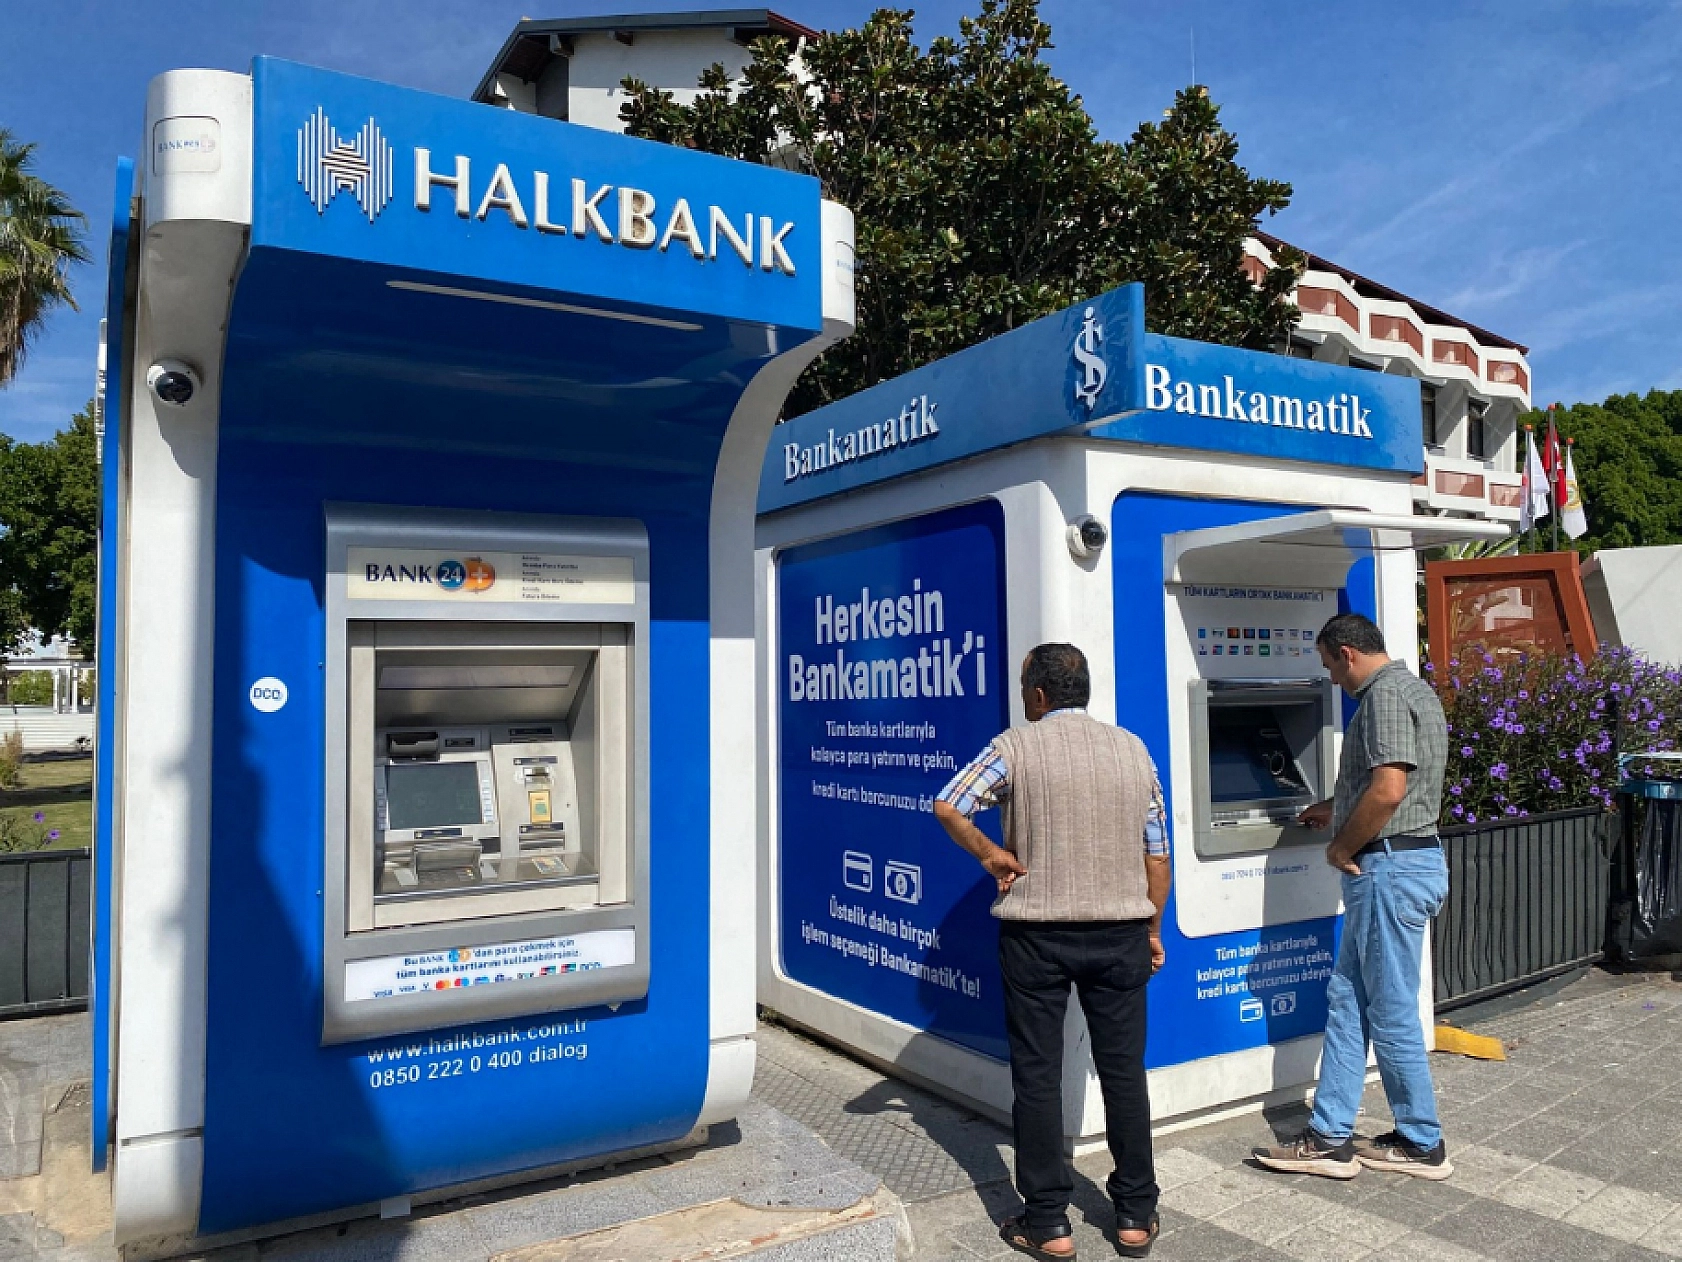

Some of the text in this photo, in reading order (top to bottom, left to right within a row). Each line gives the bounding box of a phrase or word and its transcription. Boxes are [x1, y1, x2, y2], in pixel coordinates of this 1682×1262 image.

[413, 146, 797, 276] HALKBANK
[1145, 363, 1374, 439] Bankamatik
[783, 394, 940, 482] Bankamatik
[366, 564, 433, 584] BANK
[815, 578, 945, 645] Herkesin
[789, 630, 987, 702] Bankamatik'i
[826, 720, 936, 743] Tüm banka kartlarıyla
[811, 745, 958, 773] kolayca para yatırın ve çekin,
[812, 780, 836, 799] kredi
[836, 782, 859, 802] kartı
[860, 785, 917, 811] borcunuzu
[829, 894, 941, 950] Üstelik daha birçok
[802, 919, 981, 999] işlem seçeneği Bankamatik'te!
[1196, 966, 1236, 983] kolayca
[1237, 963, 1260, 979] para
[1293, 955, 1306, 965] ve
[1215, 946, 1237, 961] Tüm
[1238, 941, 1269, 958] banka
[1197, 983, 1223, 1000] kredi
[367, 1018, 588, 1064] www.halkbank.com.tr
[370, 1042, 588, 1089] 0850 222 0 400 dialog
